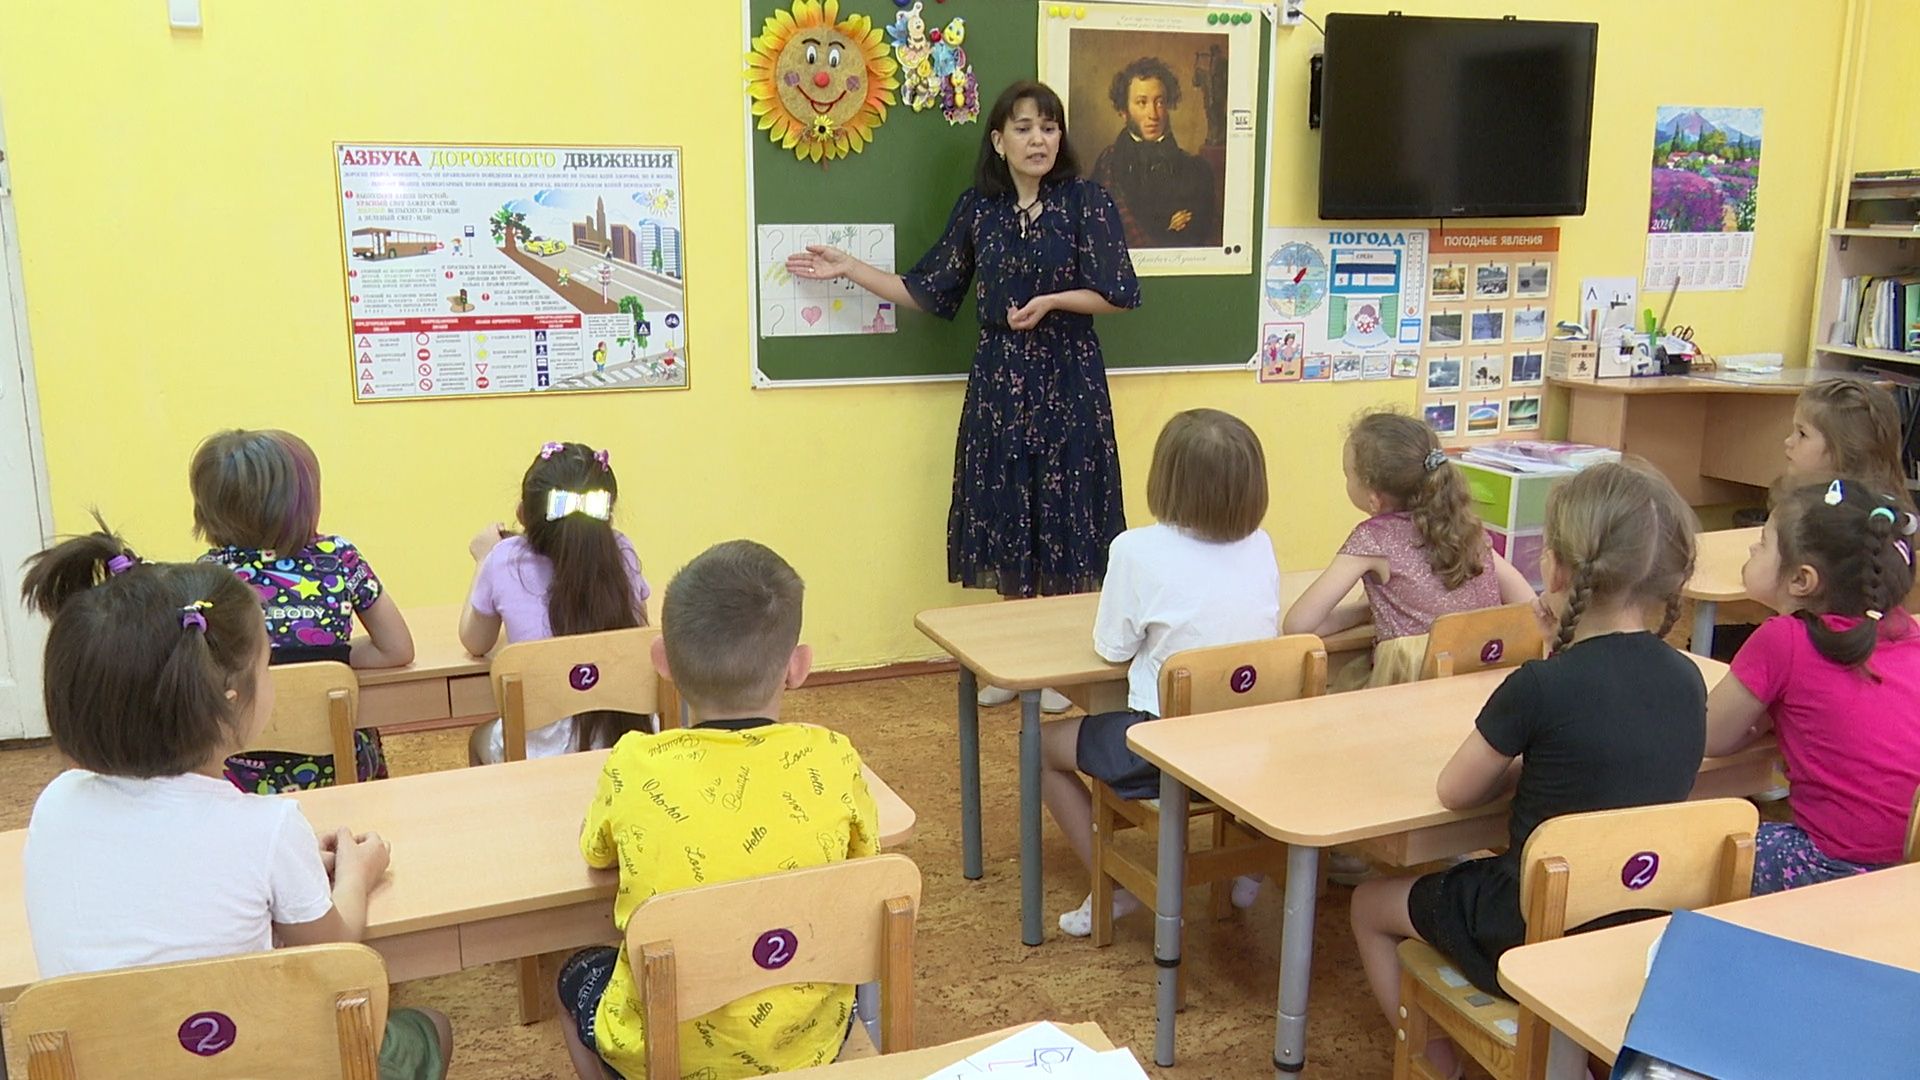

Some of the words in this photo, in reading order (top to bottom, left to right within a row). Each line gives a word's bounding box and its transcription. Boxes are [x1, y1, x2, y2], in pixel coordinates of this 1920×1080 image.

[342, 150, 422, 167] АЗБУКА
[429, 151, 556, 169] ДОРОЖНОГО
[563, 152, 674, 170] ДВИЖЕНИЯ
[1651, 218, 1675, 230] 2024
[1328, 231, 1406, 247] ПОГОДА
[1443, 235, 1498, 248] ПОГОДНЫЕ
[1500, 234, 1543, 246] ЯВЛЕНИЯ
[1487, 644, 1498, 660] 2
[579, 667, 595, 686] 2
[1240, 671, 1252, 690] 2
[779, 747, 813, 770] Love
[722, 766, 750, 813] Beautiful
[808, 768, 824, 796] Hello
[642, 778, 690, 824] O-ho-ho!
[742, 826, 767, 855] Hello
[685, 846, 706, 883] Love
[1629, 855, 1655, 886] 2
[766, 936, 790, 964] 2
[749, 1001, 774, 1029] Hello
[190, 1017, 226, 1052] 2
